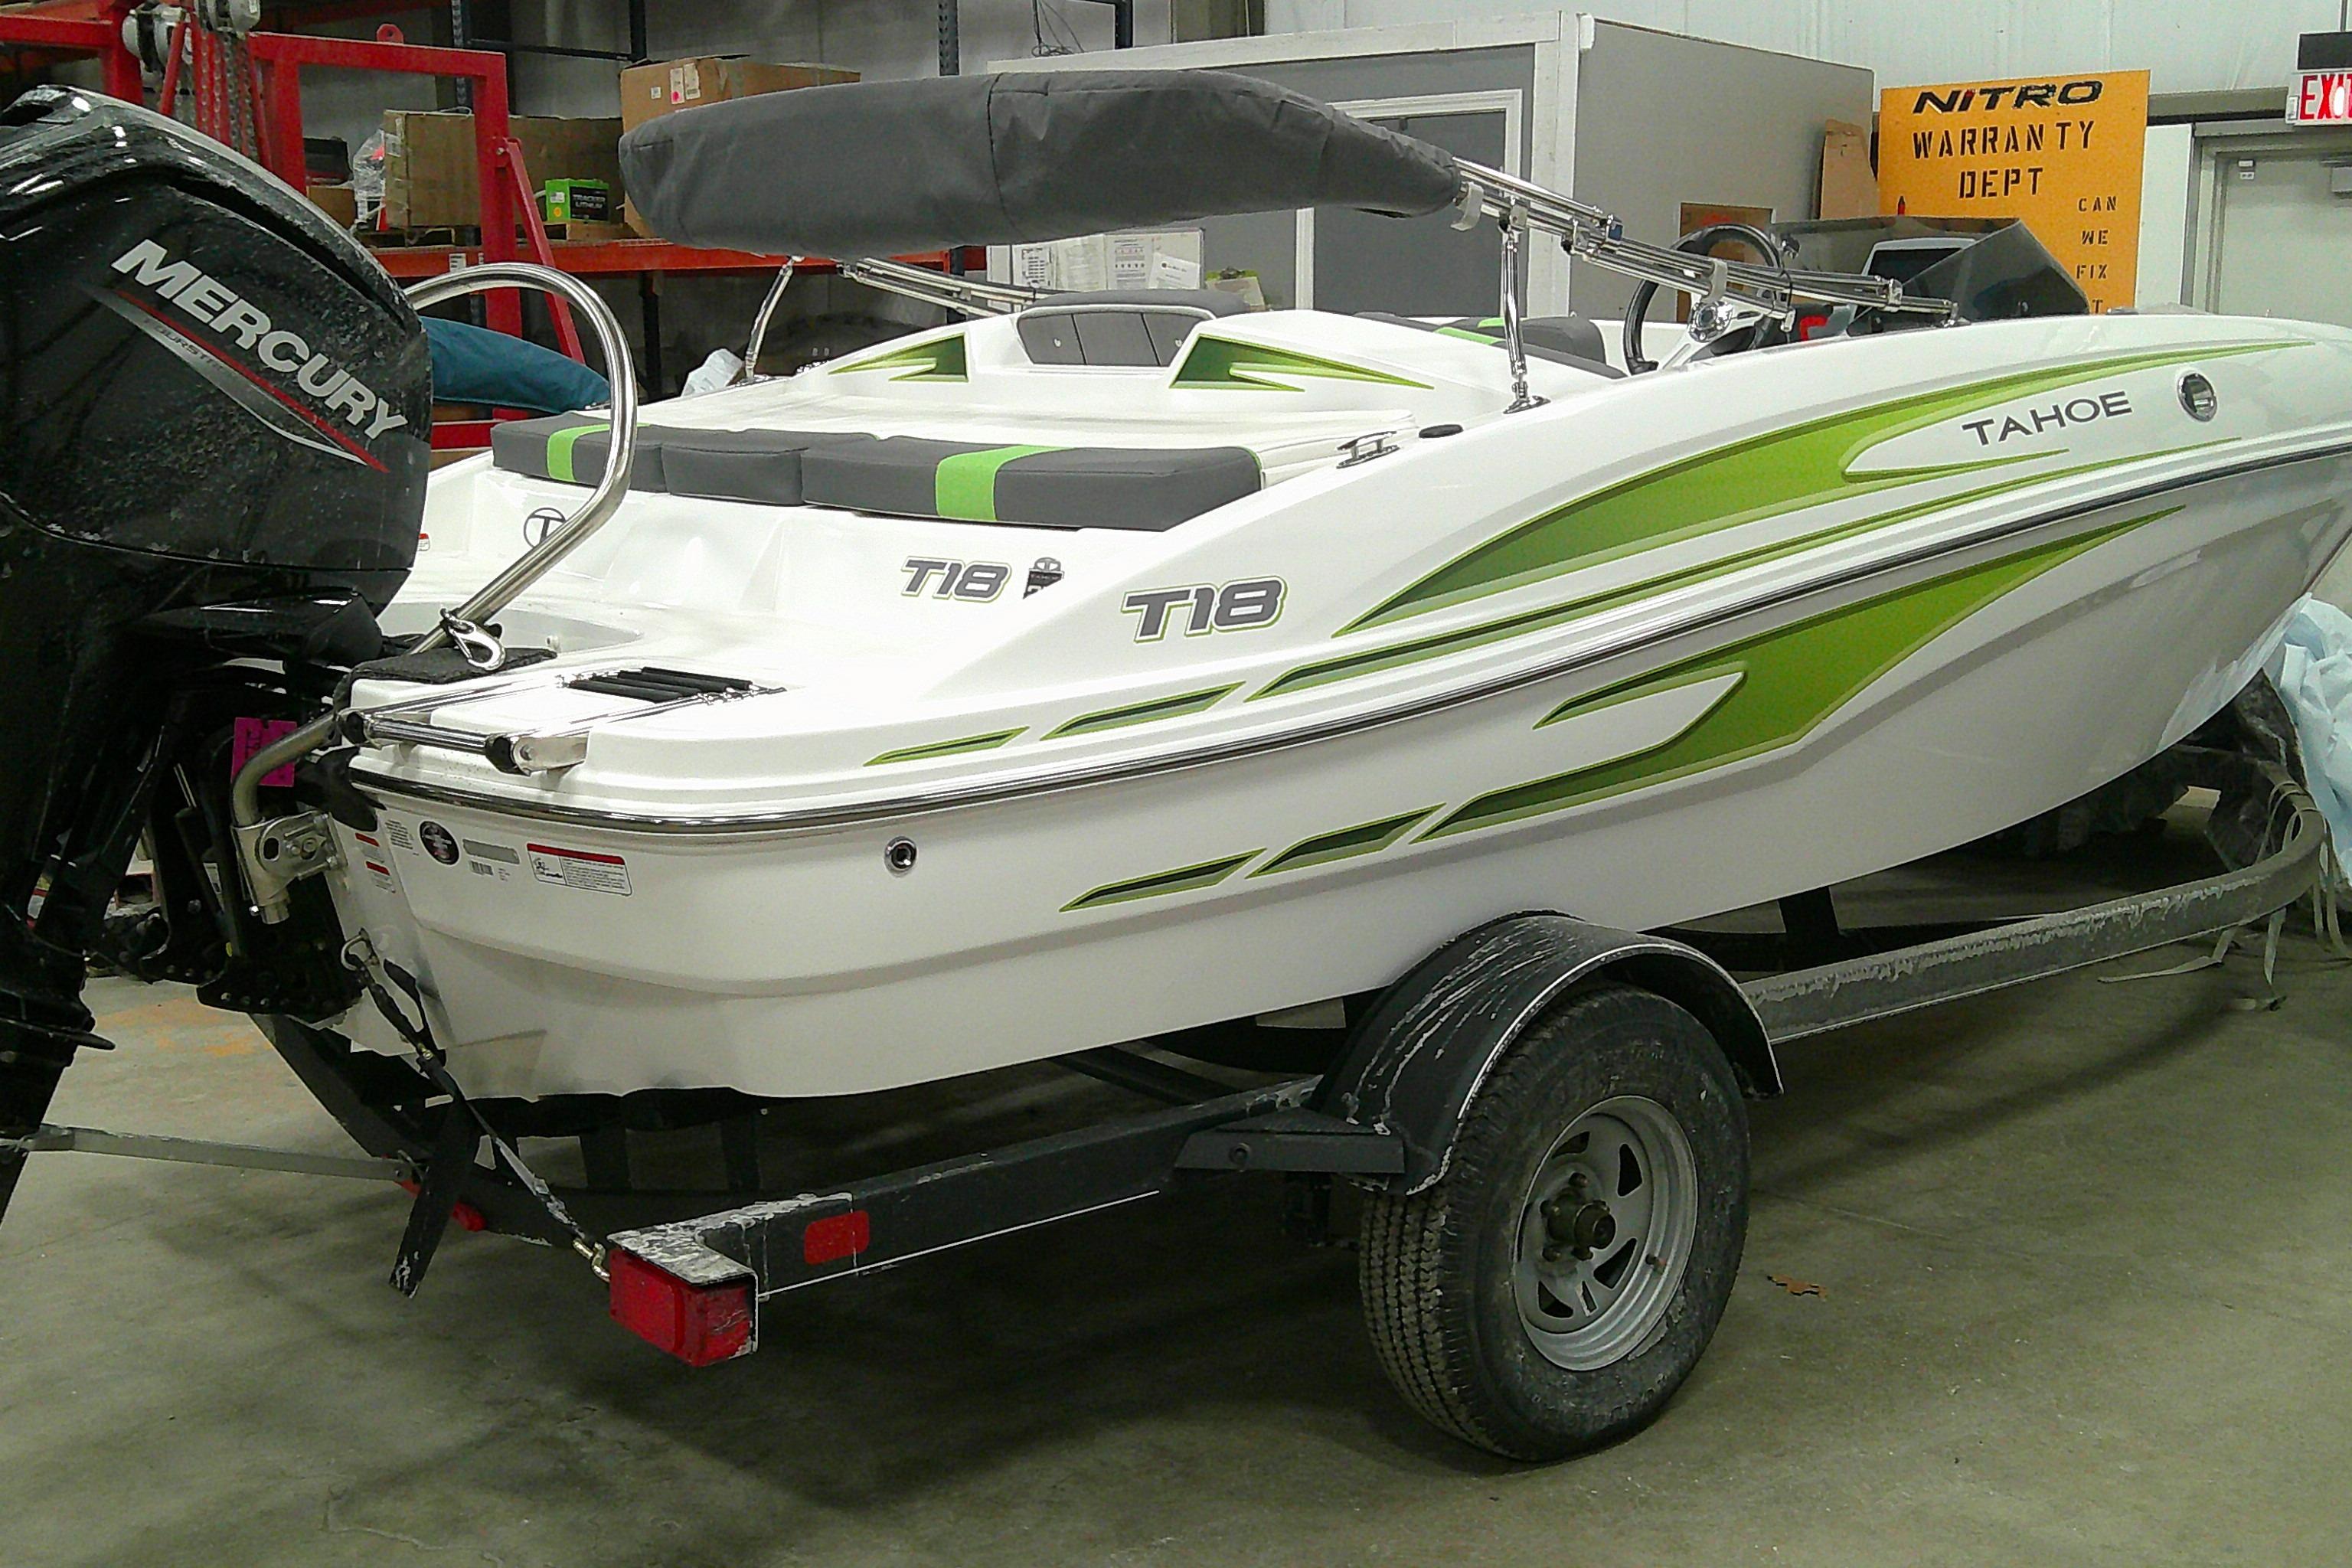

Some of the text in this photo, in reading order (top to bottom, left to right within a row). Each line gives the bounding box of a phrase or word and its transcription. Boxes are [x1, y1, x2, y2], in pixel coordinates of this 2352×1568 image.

[1913, 81, 2102, 113] NITRO
[2299, 74, 2352, 119] EX
[1913, 120, 2095, 159] WARRANTY
[1959, 168, 2043, 199] DEPT
[2078, 196, 2117, 212] CAN
[2082, 230, 2109, 245] WE
[2076, 264, 2108, 279] FIX
[111, 239, 408, 439] MERCURY
[1962, 390, 2133, 446] TAHOE
[901, 557, 1011, 602] T18
[1122, 577, 1286, 641] T18
